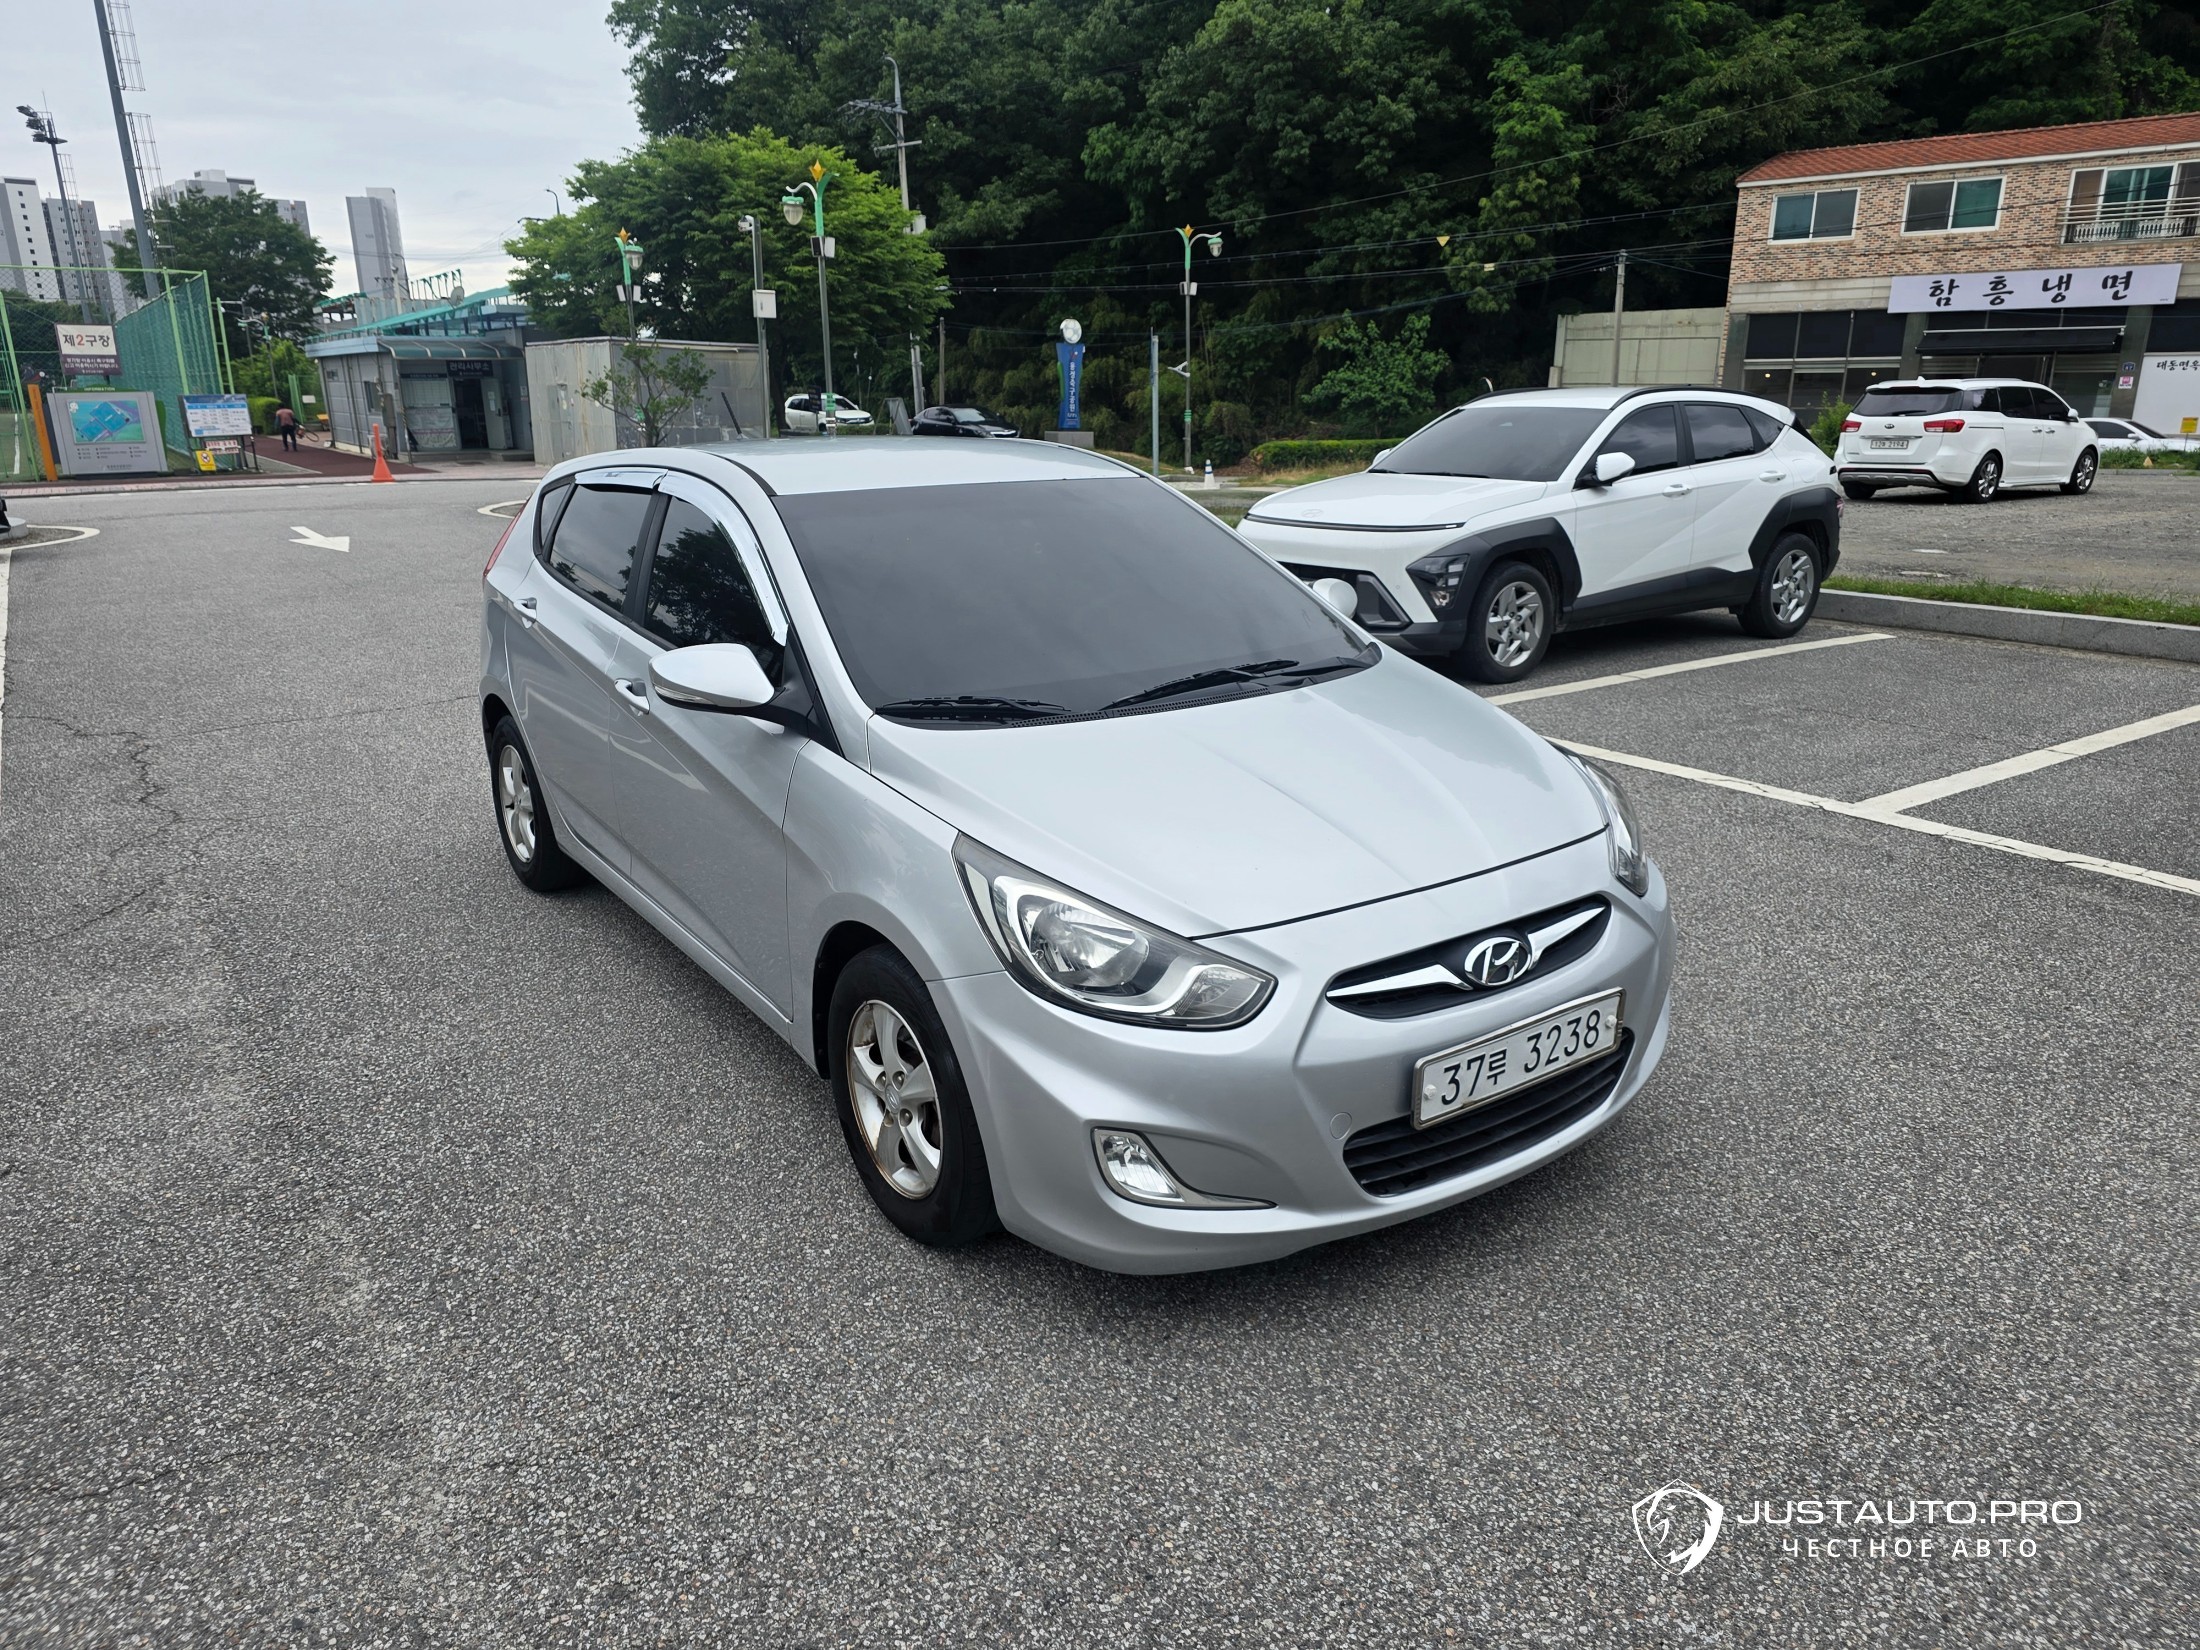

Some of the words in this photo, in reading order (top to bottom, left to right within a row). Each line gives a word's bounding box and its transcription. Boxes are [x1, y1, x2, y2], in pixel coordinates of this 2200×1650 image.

[1929, 271, 2134, 307] 함흥냉면
[62, 334, 110, 348] 제2구장
[1441, 1048, 1508, 1105] 37루
[1523, 1009, 1601, 1073] 3238
